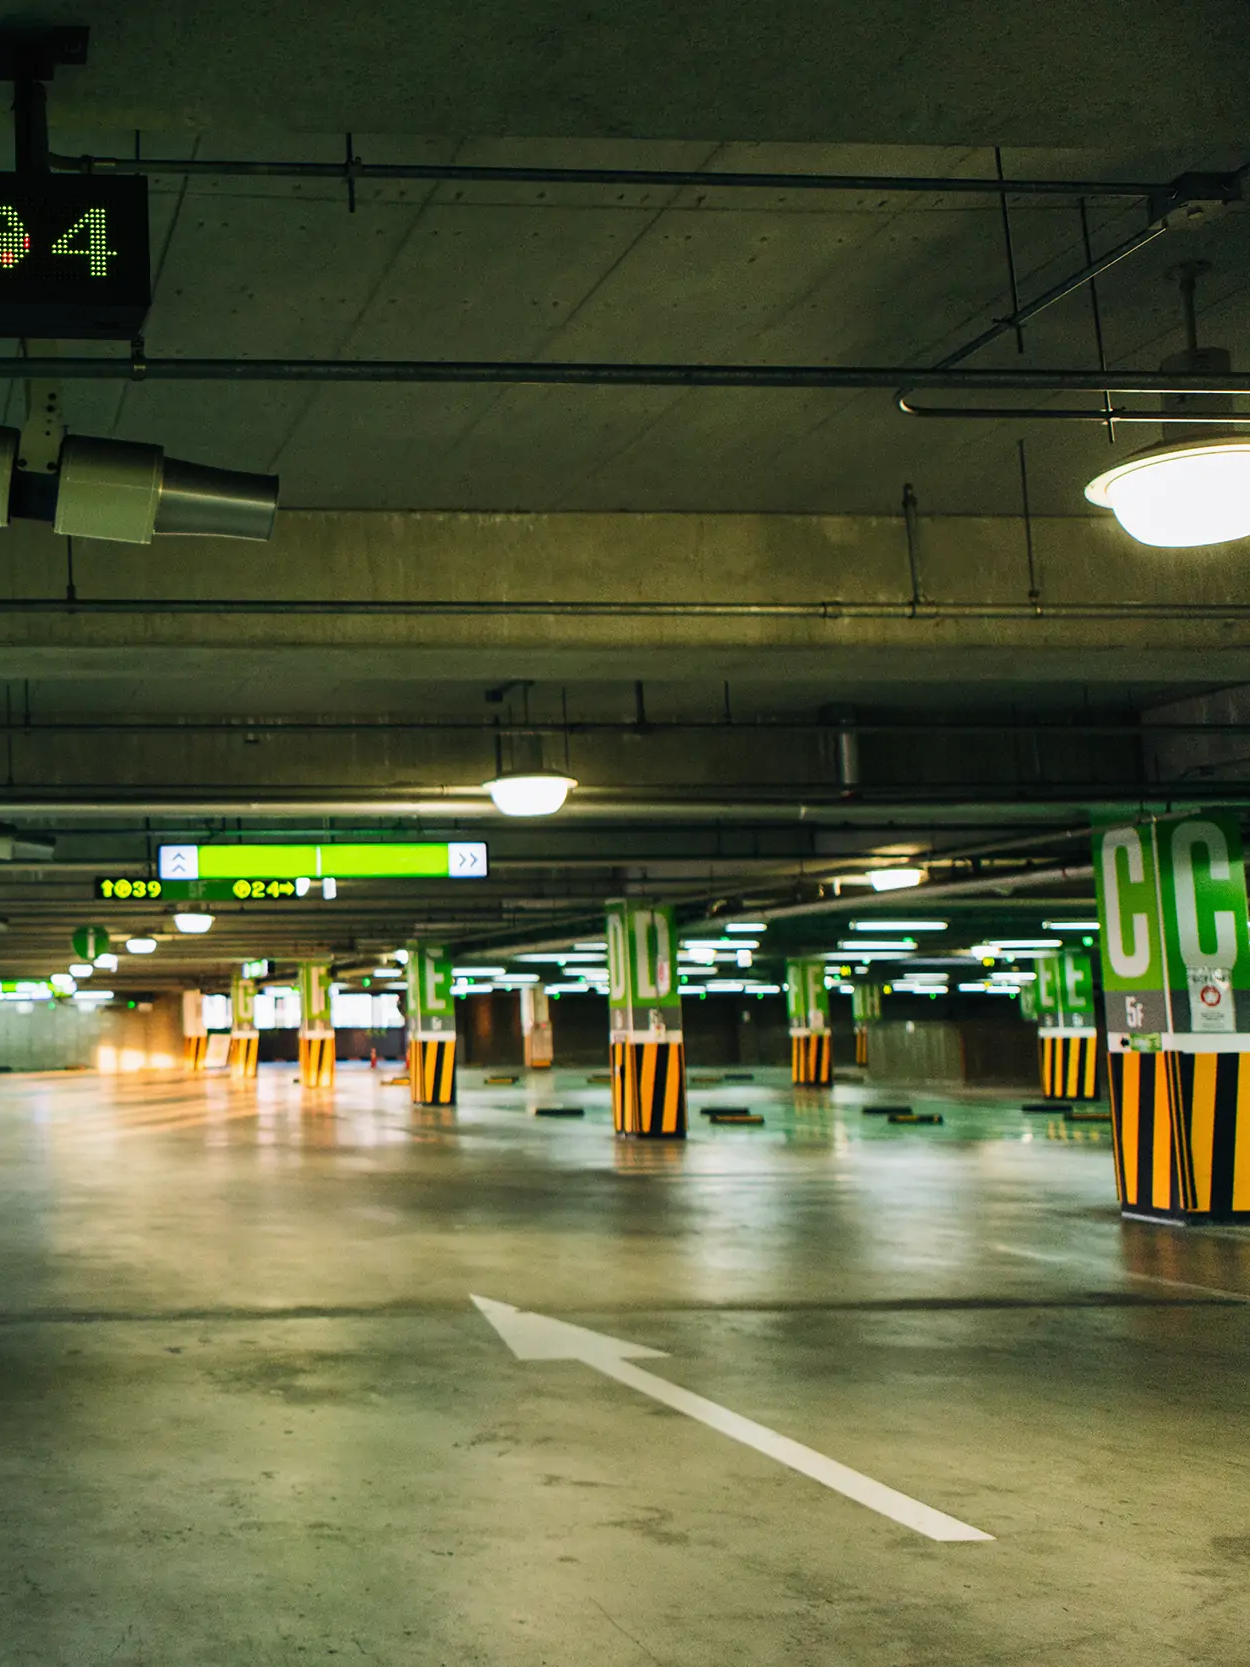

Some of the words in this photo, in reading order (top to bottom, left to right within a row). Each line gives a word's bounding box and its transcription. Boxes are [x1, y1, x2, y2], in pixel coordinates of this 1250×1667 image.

[52, 208, 118, 276] 4
[1102, 827, 1150, 978] C
[1171, 821, 1238, 968] C
[426, 948, 446, 1010] E
[635, 910, 671, 999] D
[1064, 949, 1087, 1008] E
[1125, 996, 1144, 1028] 5F
